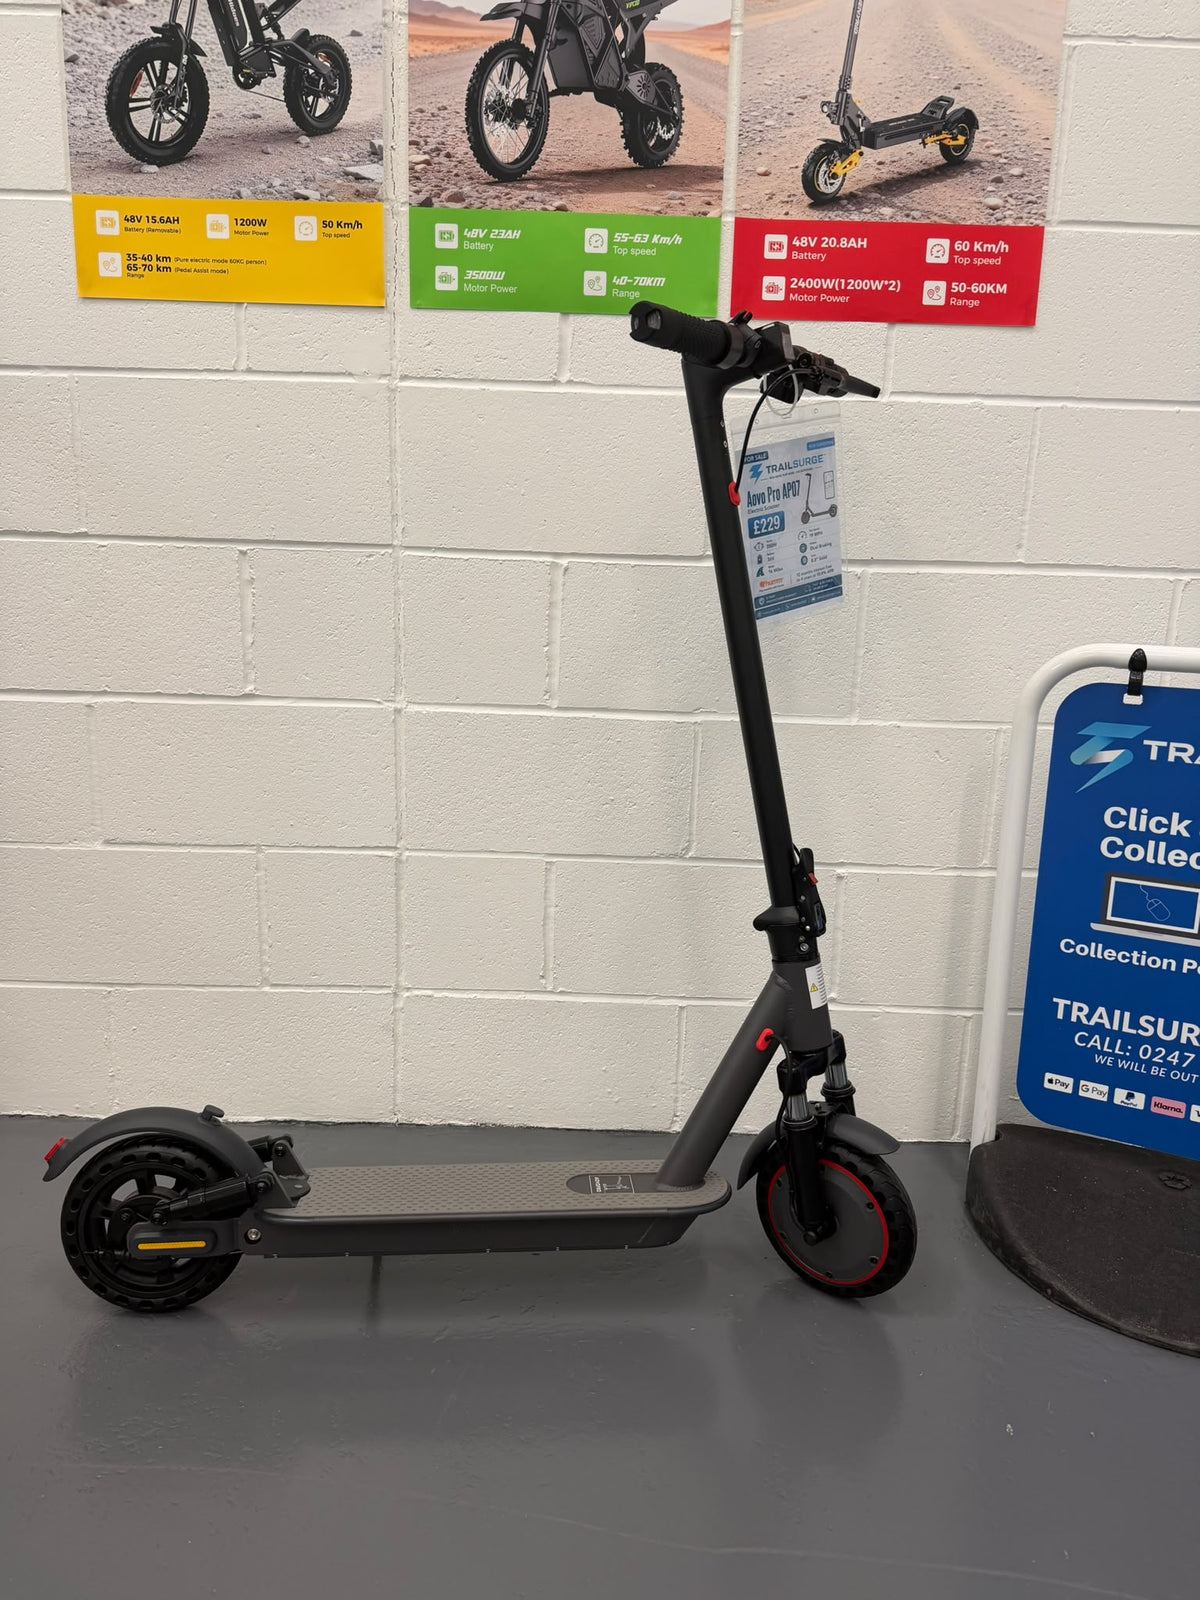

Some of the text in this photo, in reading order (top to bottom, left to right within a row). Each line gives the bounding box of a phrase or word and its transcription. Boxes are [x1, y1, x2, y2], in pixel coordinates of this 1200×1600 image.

[124, 214, 180, 225] 48V 15.6AH
[234, 218, 267, 227] 1200W
[322, 220, 363, 230] 50 Km/h
[124, 226, 181, 235] Battery (Removable)
[463, 228, 521, 240] 48V 23AH
[613, 232, 683, 245] 55-63 Km/h
[792, 236, 868, 249] 48V 20.8AH
[463, 241, 494, 252] Battery
[612, 246, 657, 256] Top speed
[954, 240, 1009, 253] 60 Km/h
[126, 253, 153, 263] 35-40
[156, 254, 172, 263] km
[791, 251, 827, 262] Battery
[953, 255, 1002, 266] Top speed
[126, 263, 154, 273] 65-70
[156, 264, 172, 273] km
[463, 270, 506, 281] 3500W
[612, 276, 666, 287] 40-70KM
[463, 284, 518, 294] Motor Power
[950, 282, 1008, 294] 50-60KM
[612, 289, 641, 299] Range
[789, 293, 850, 303] Motor Power
[950, 297, 981, 308] Range
[766, 454, 824, 474] TRAILSURGE
[746, 479, 801, 508] Aovo Pro AP07
[753, 515, 781, 535] £229
[1143, 739, 1200, 765] TR
[1103, 806, 1193, 838] Click
[1060, 938, 1200, 975] Collection P
[1053, 997, 1200, 1047] TRAILSUR
[1074, 1031, 1196, 1068] CALL: 0247
[1094, 1053, 1200, 1084] WE WILL BE OUT
[1054, 1078, 1070, 1089] Pay
[1091, 1086, 1108, 1098] Pay
